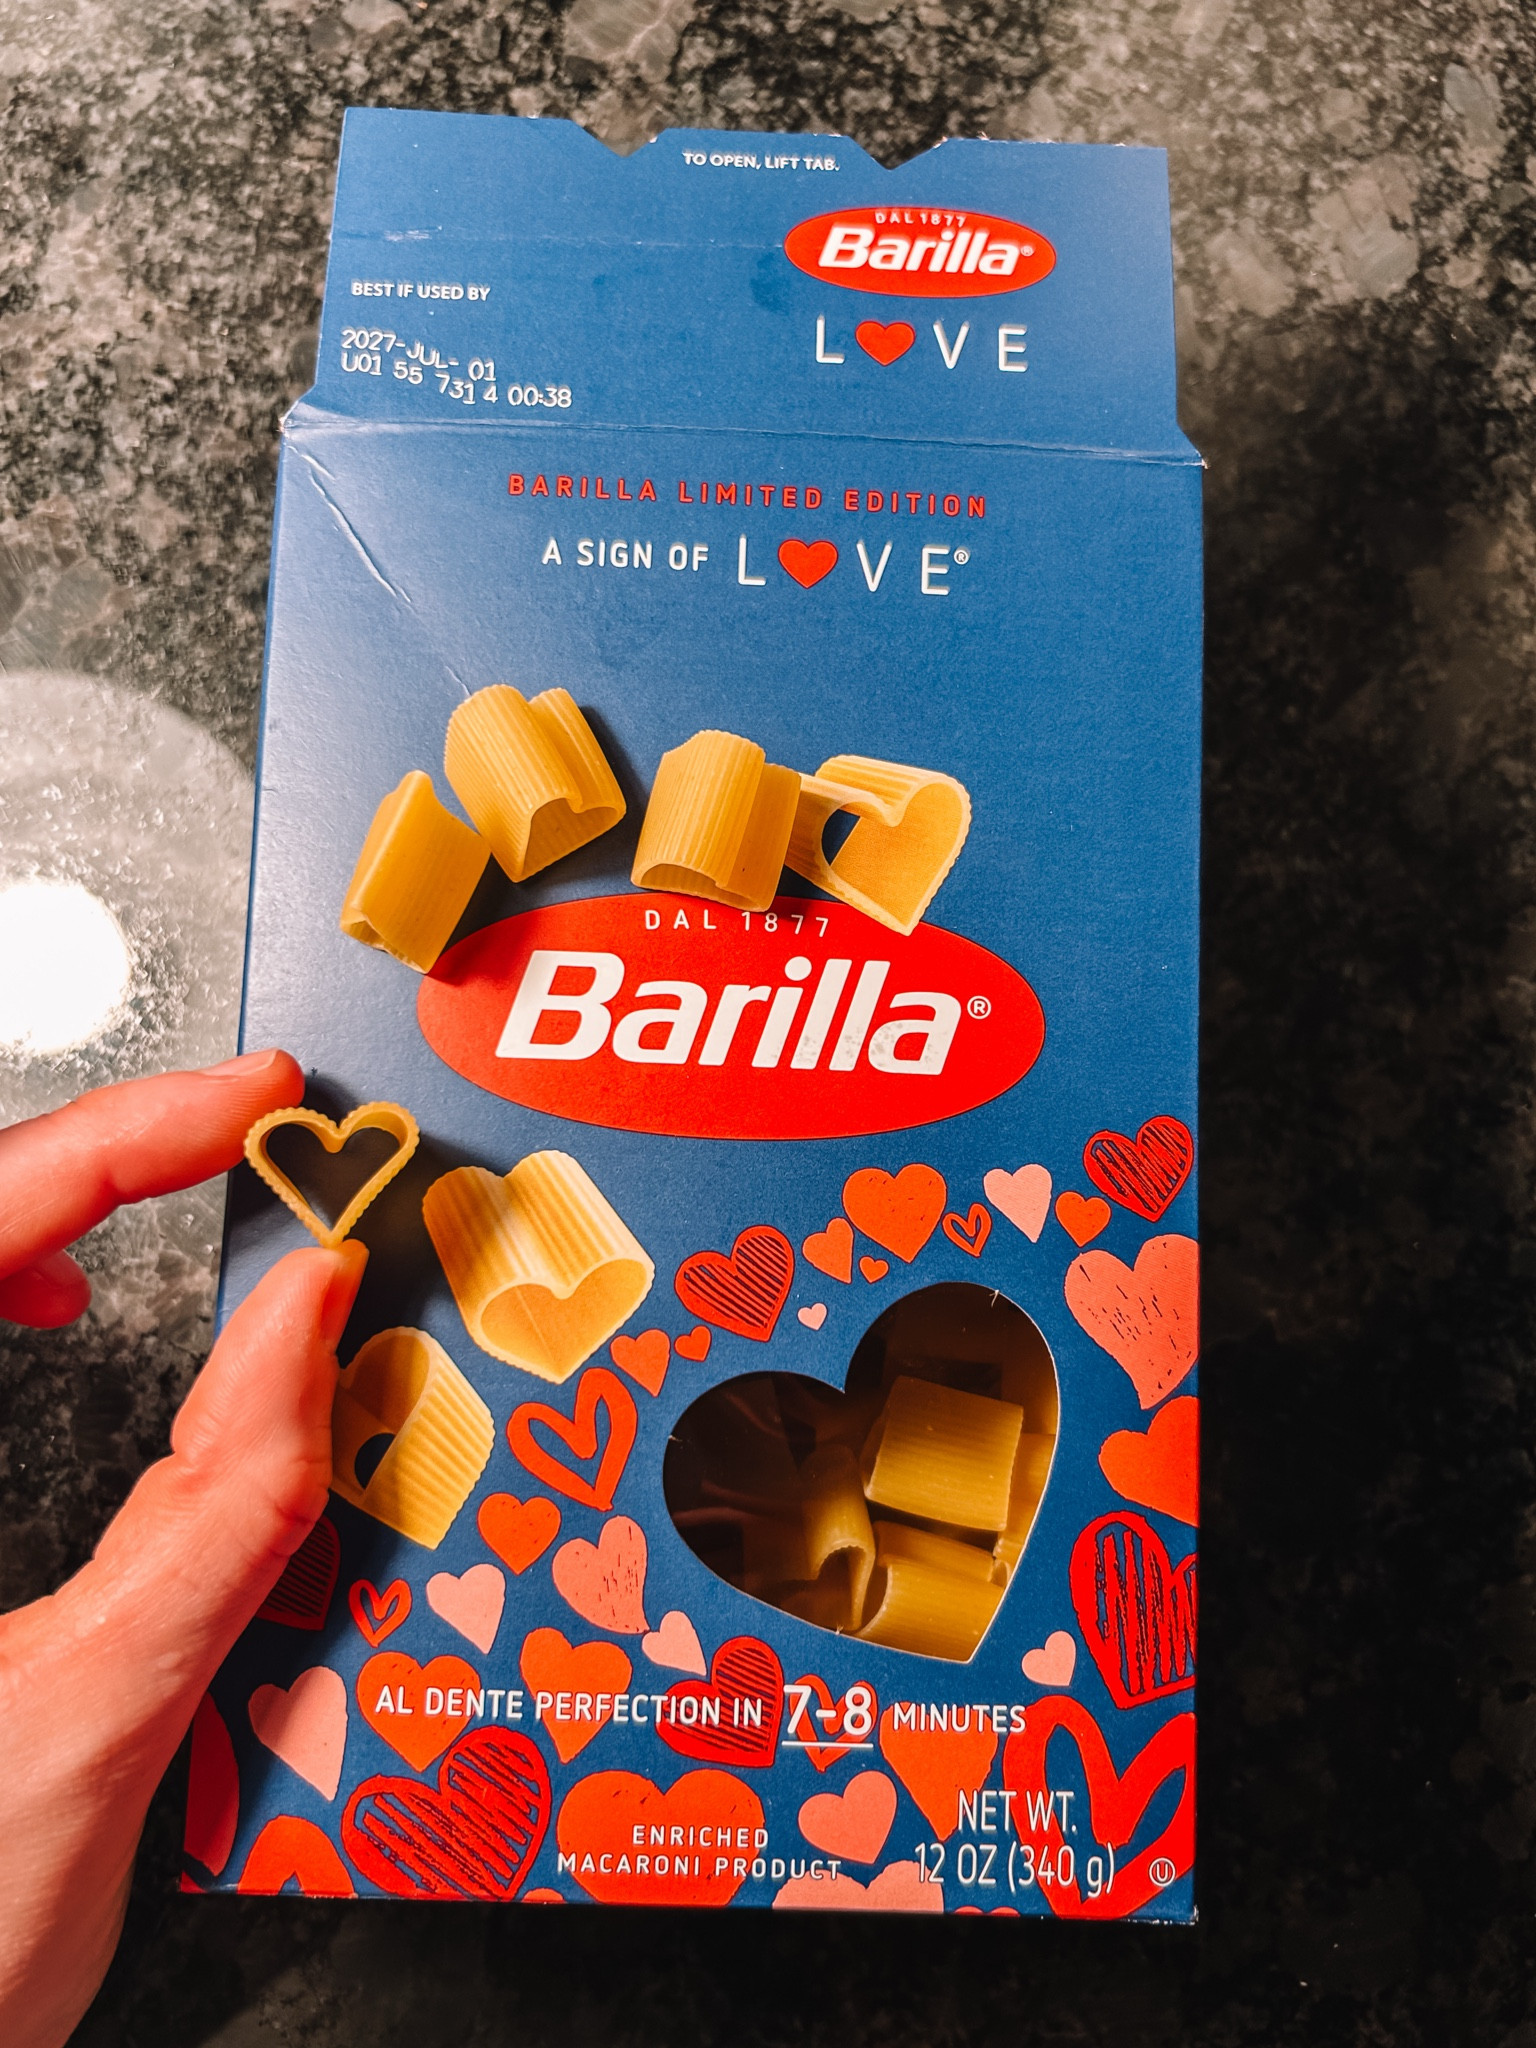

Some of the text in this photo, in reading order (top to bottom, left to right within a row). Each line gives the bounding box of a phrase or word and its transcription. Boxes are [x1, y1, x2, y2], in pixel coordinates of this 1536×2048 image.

[683, 152, 841, 171] TO OPEN, LIFT TAB.
[874, 210, 967, 228] DAL 1877
[351, 281, 491, 301] BEST IF USED BY
[341, 352, 382, 376] U01
[393, 360, 424, 385] 55
[483, 385, 499, 404] 4
[507, 385, 573, 409] 00:38
[468, 357, 497, 382] 01
[508, 474, 986, 519] BARILLA LIMITED EDITION
[542, 537, 562, 566] A
[577, 538, 653, 569] SIGN
[669, 543, 710, 572] OF
[645, 909, 830, 938] DAL 1877
[375, 1683, 1027, 1736] AL DENTE PERFECTION IN 7-8 MINUTES
[957, 1789, 1078, 1833] NET WT.
[632, 1824, 770, 1850] ENRICHED
[556, 1852, 842, 1881] MACARONI PRODUCT
[914, 1840, 1115, 1898] 12 OZ (340 g)
